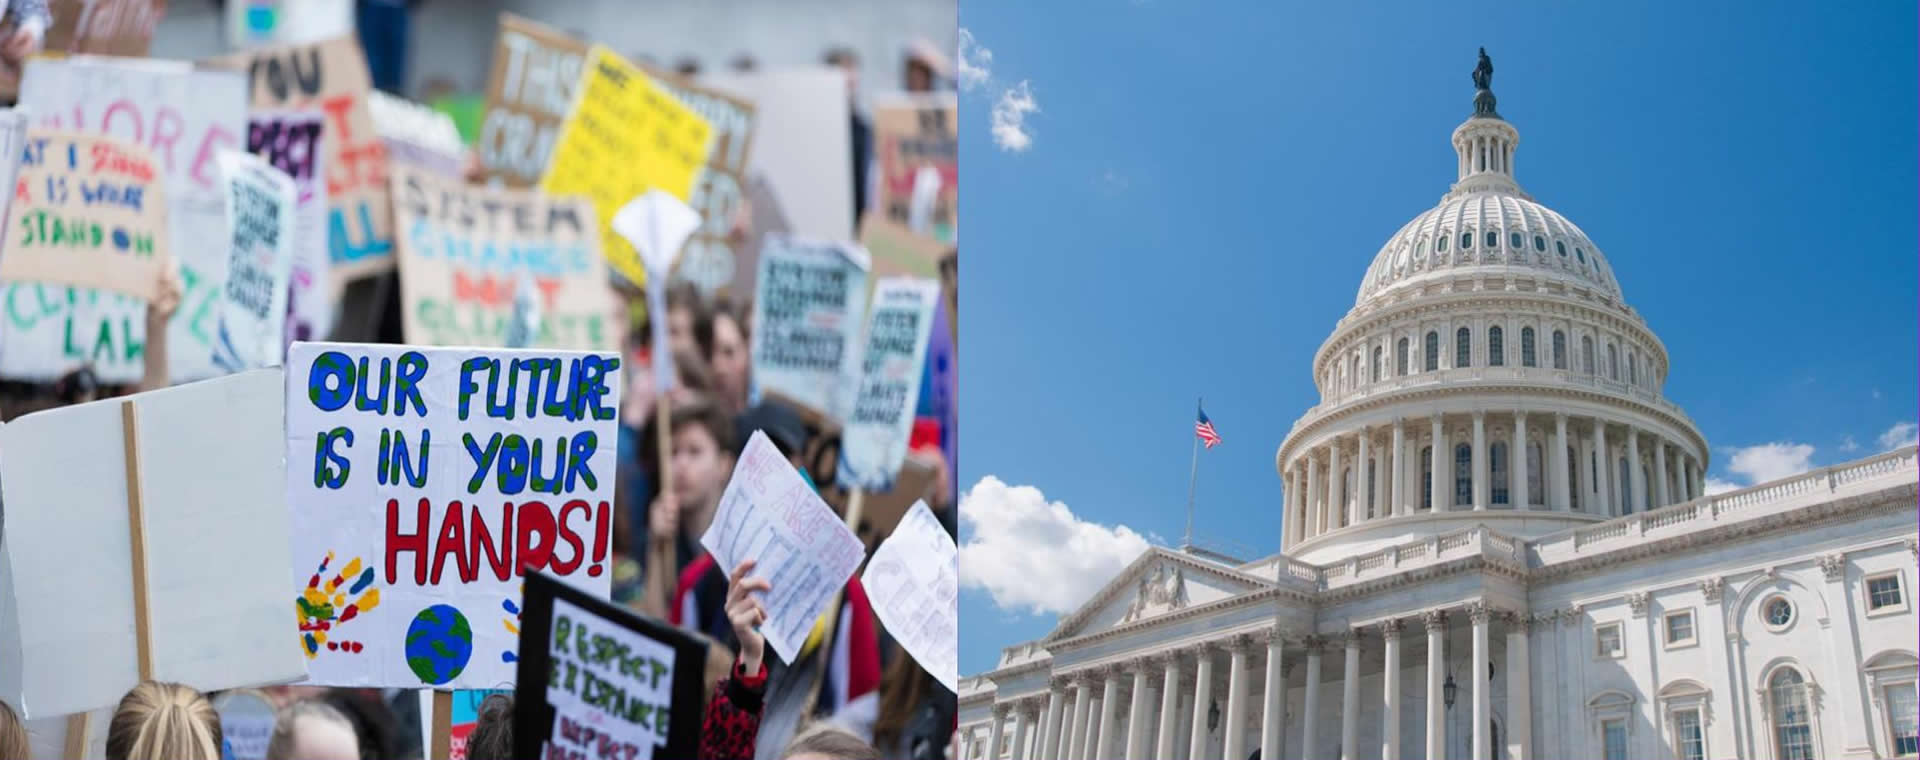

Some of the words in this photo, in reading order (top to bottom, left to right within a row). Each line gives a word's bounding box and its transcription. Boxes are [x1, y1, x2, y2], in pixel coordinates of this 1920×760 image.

[308, 350, 429, 418] OUR
[457, 354, 622, 422] FUTURE
[313, 425, 355, 490] IS
[377, 427, 430, 489] IN
[462, 429, 599, 496] YOUR
[384, 496, 611, 587] HANDS!
[555, 614, 669, 692] RESPECT
